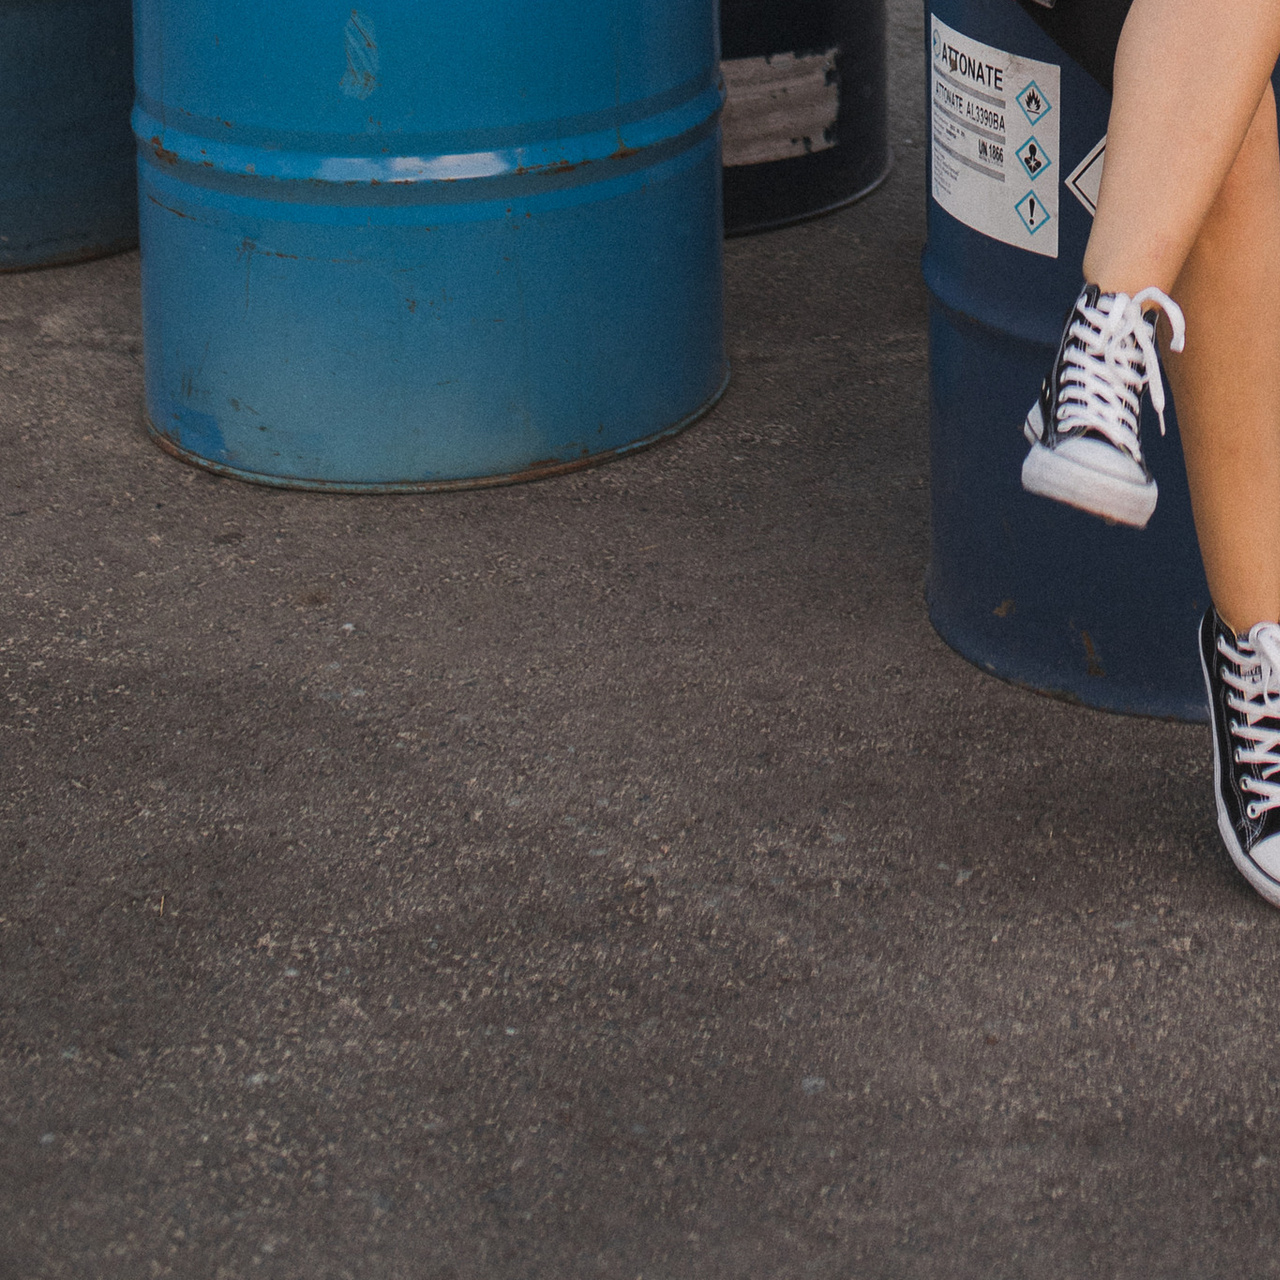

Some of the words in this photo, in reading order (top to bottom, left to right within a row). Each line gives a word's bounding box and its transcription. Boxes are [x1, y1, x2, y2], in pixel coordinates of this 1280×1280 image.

[942, 42, 1003, 92] ATTONATE
[936, 80, 963, 114] ATTONATE
[979, 139, 988, 157] UN
